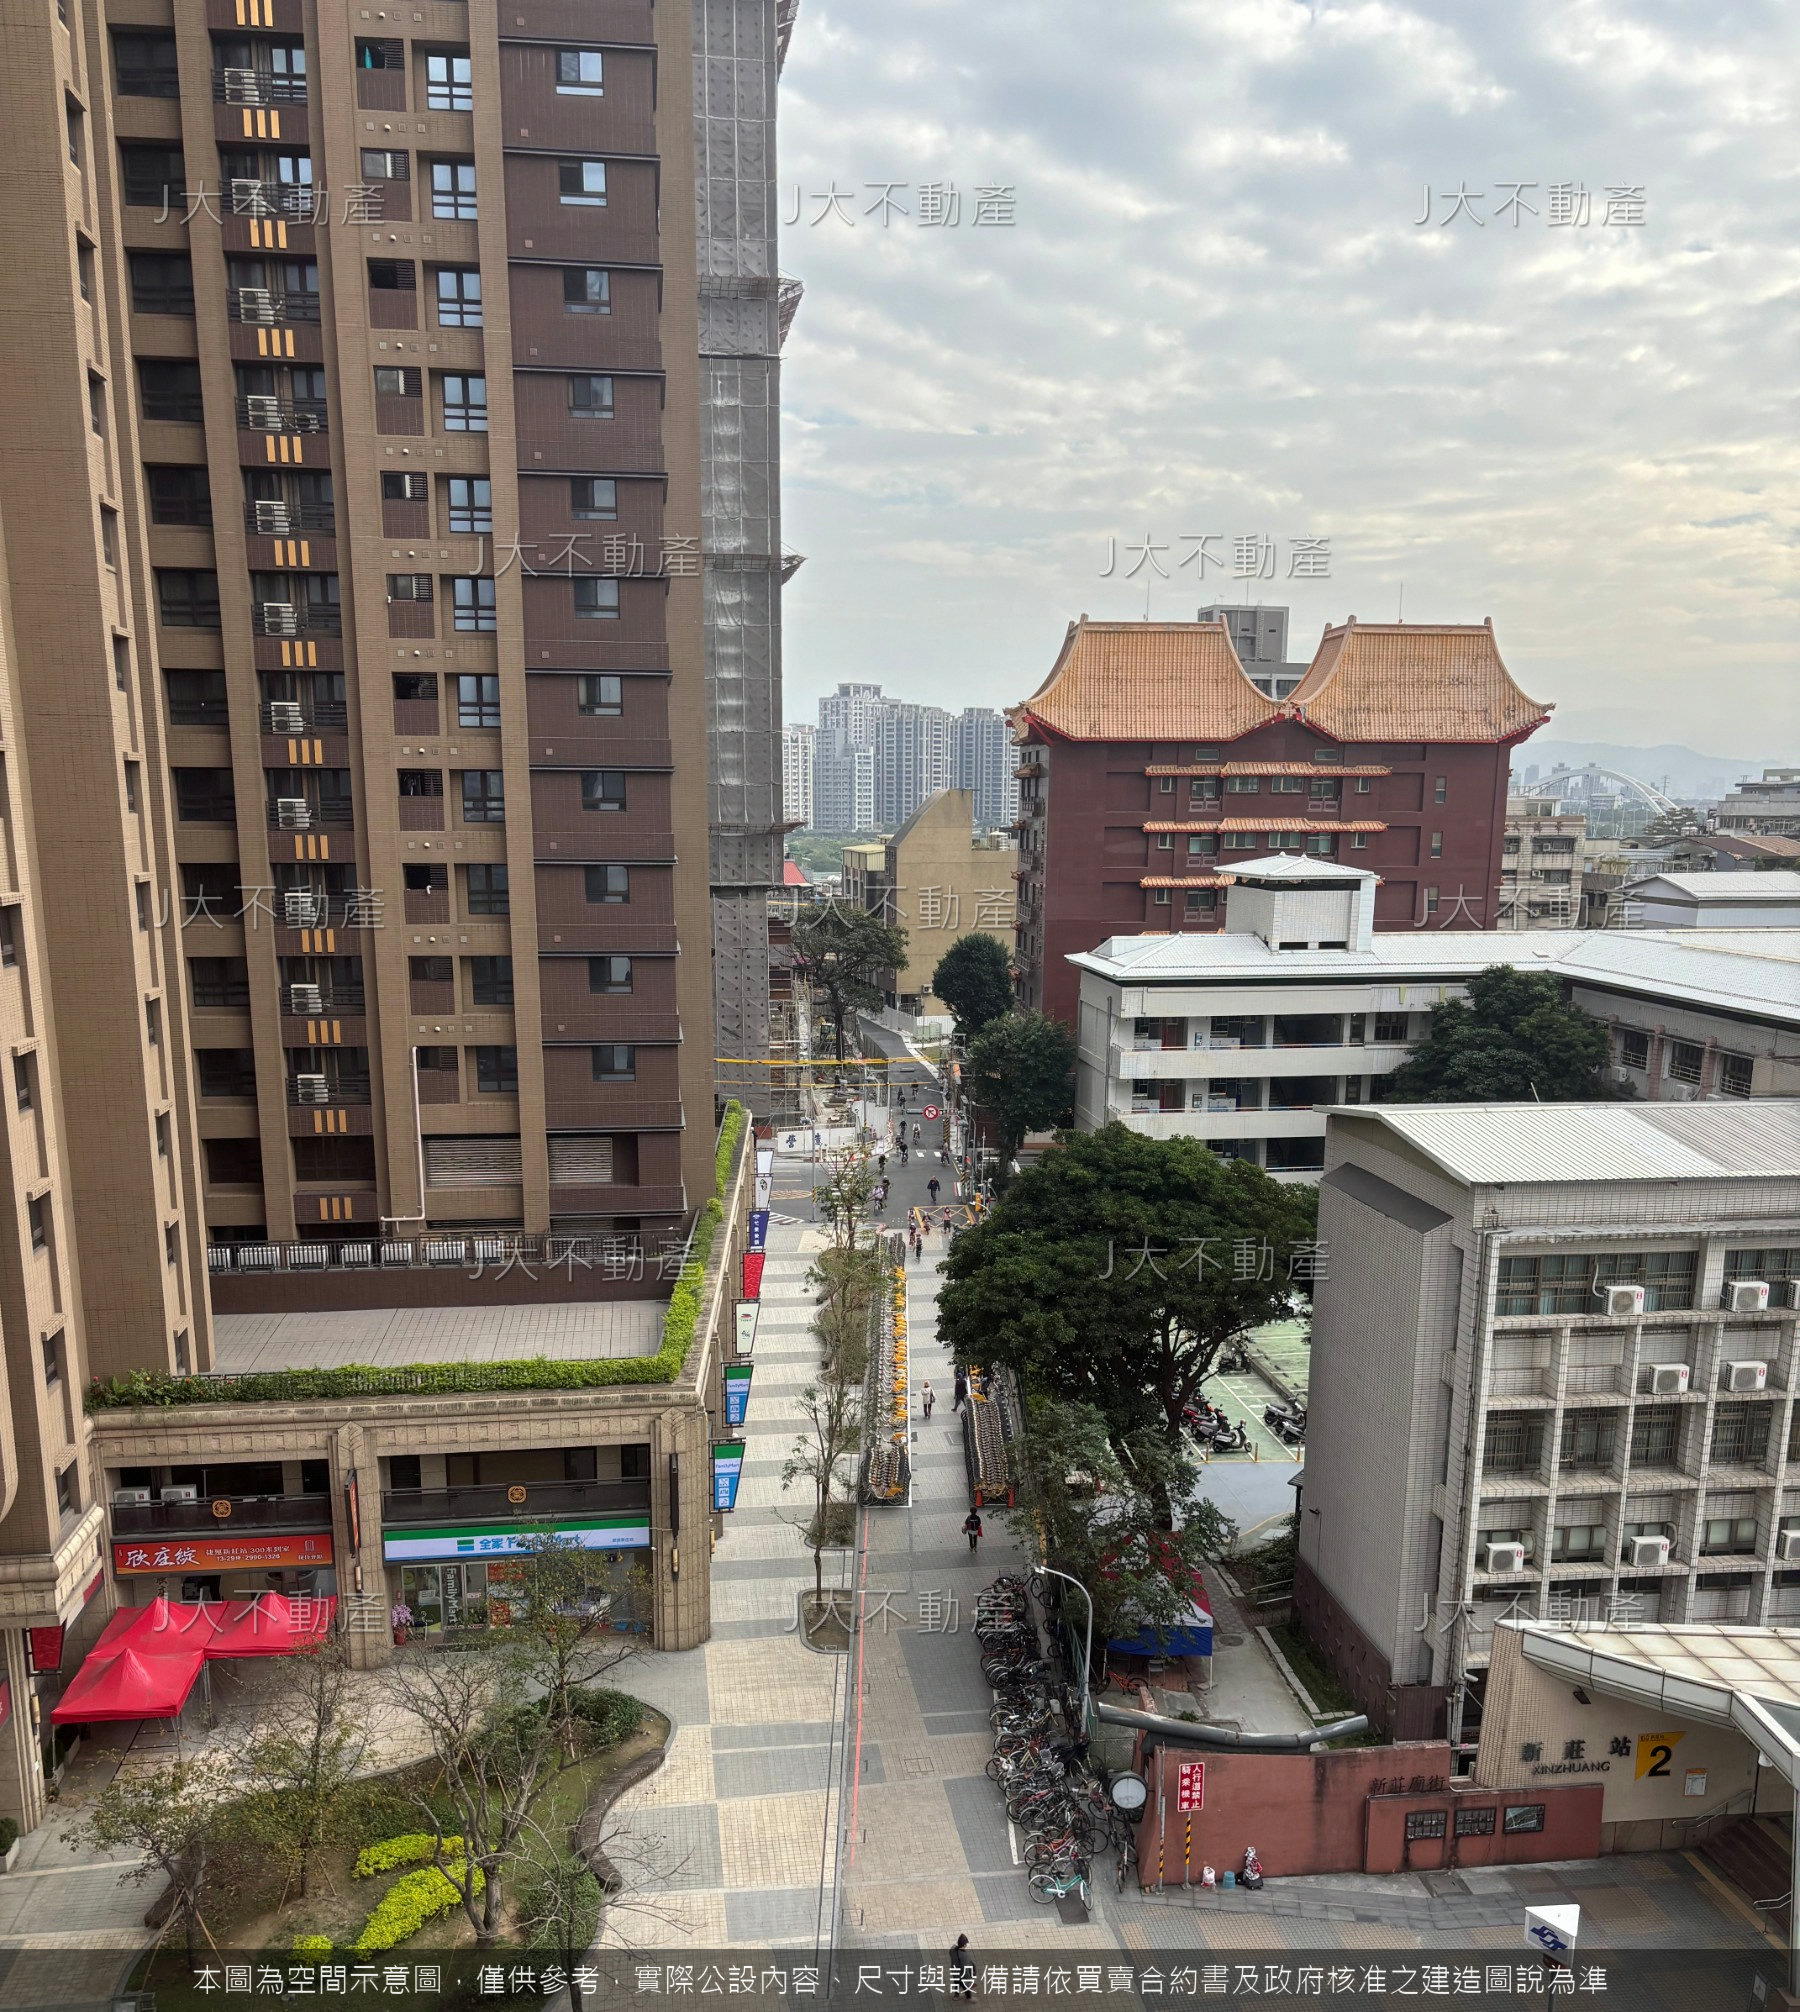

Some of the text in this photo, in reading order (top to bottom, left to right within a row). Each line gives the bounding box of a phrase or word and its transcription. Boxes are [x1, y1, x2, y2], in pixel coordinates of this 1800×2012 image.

[719, 1487, 729, 1495] ATM
[479, 1537, 503, 1550] 全家
[446, 1568, 458, 1623] FamilyMart
[1533, 1761, 1611, 1776] XINZHUANG
[1648, 1745, 1672, 1776] 2
[1191, 1764, 1202, 1809] 人行道禁止
